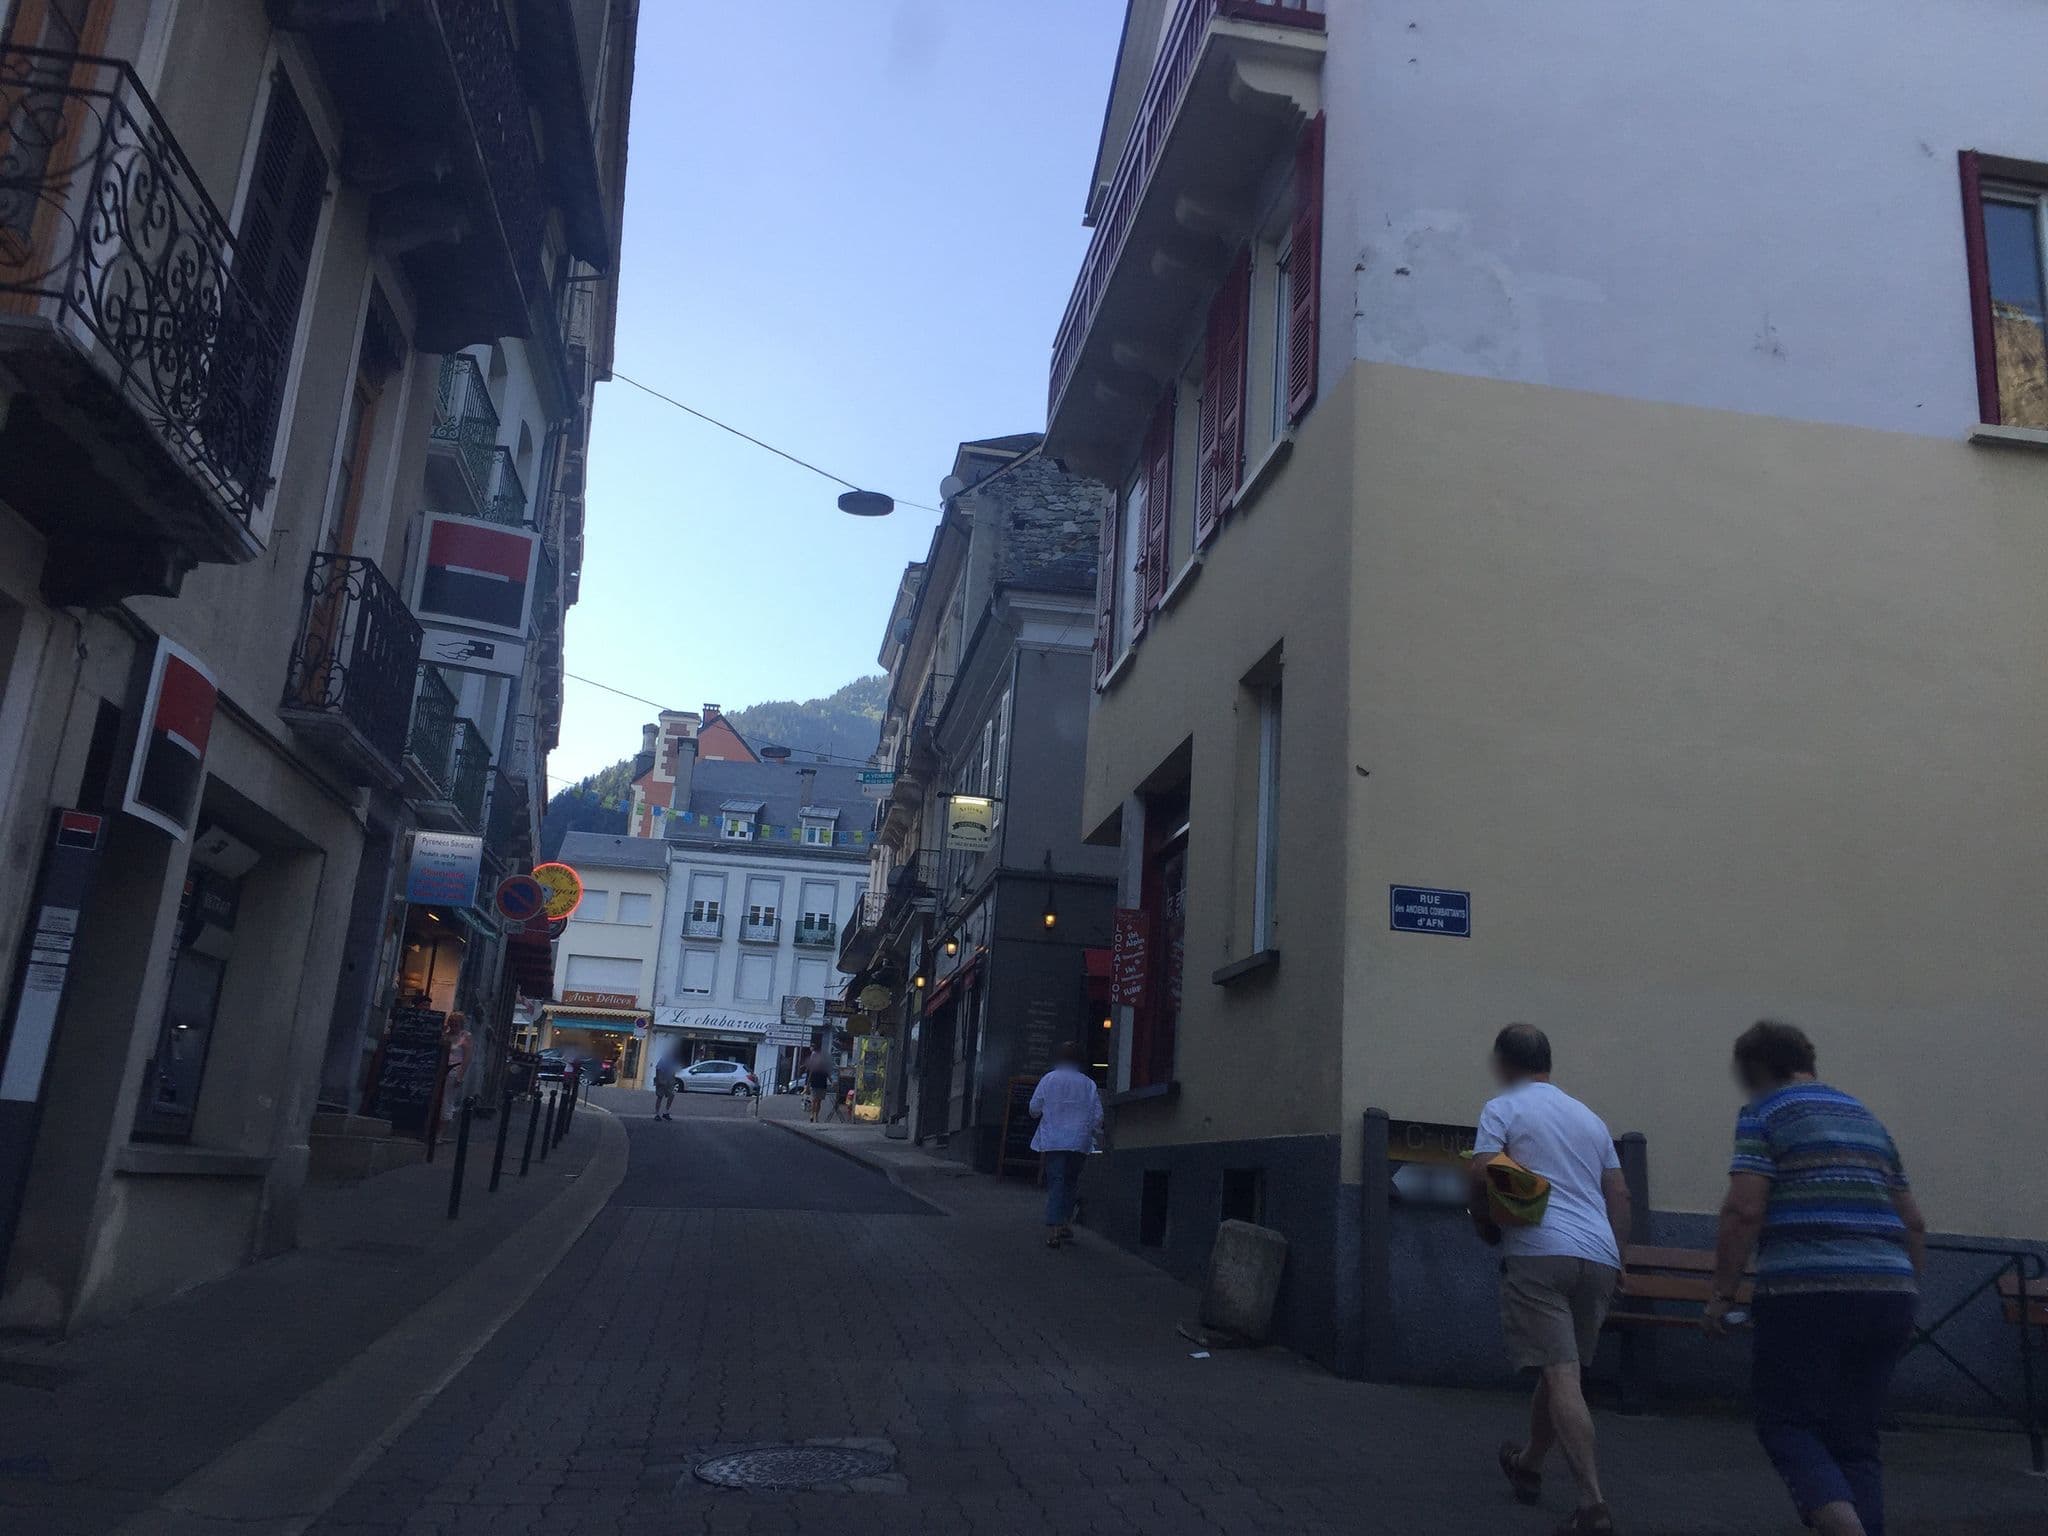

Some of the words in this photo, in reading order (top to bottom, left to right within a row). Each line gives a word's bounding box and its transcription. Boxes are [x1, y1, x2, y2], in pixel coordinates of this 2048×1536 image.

[1420, 894, 1441, 905] RUE
[1406, 904, 1428, 915] ANCIENS
[1429, 906, 1466, 919] COMBATTANTS
[1417, 917, 1444, 928] d'AFN
[1112, 923, 1123, 1002] LOCATION
[565, 992, 593, 1003] Aux
[672, 1008, 691, 1024] Le
